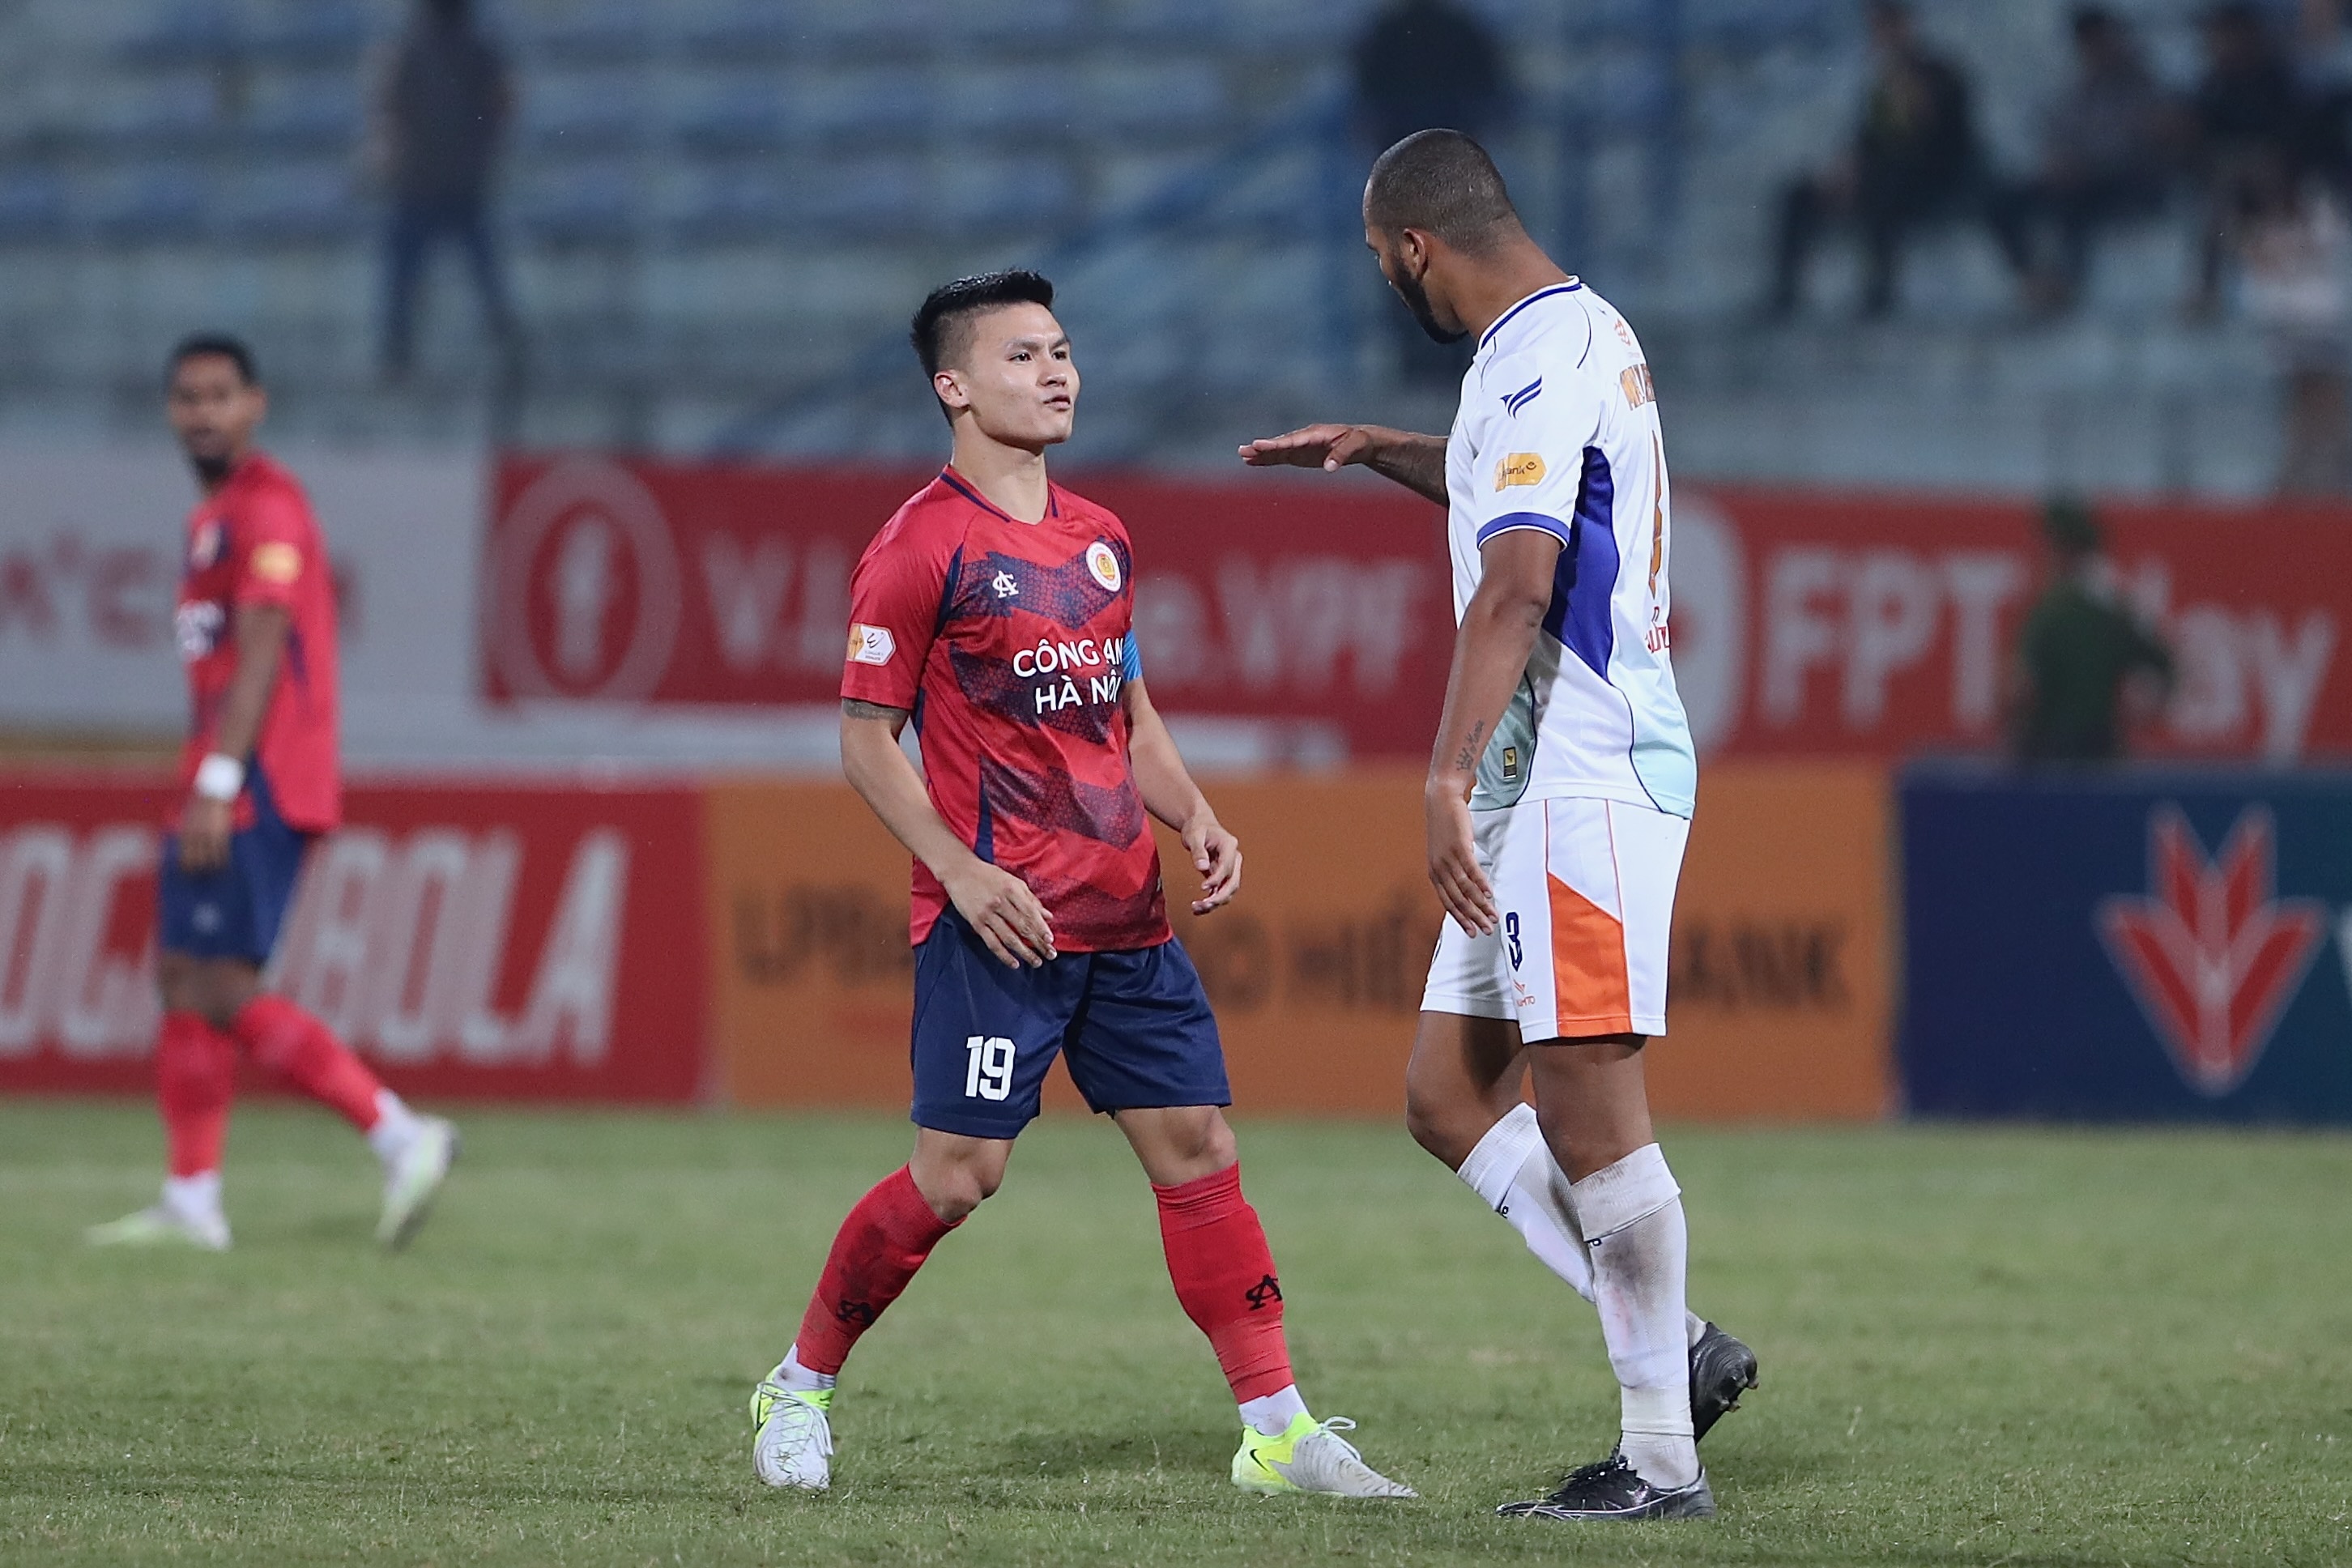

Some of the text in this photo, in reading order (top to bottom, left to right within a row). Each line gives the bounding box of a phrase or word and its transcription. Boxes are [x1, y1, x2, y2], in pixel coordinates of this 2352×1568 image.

[1013, 637, 1124, 677] CÔNG AN
[1758, 543, 2018, 731] FPT
[1035, 675, 1083, 714] HÀ
[1506, 912, 1523, 972] 3
[965, 1036, 1016, 1101] 19
